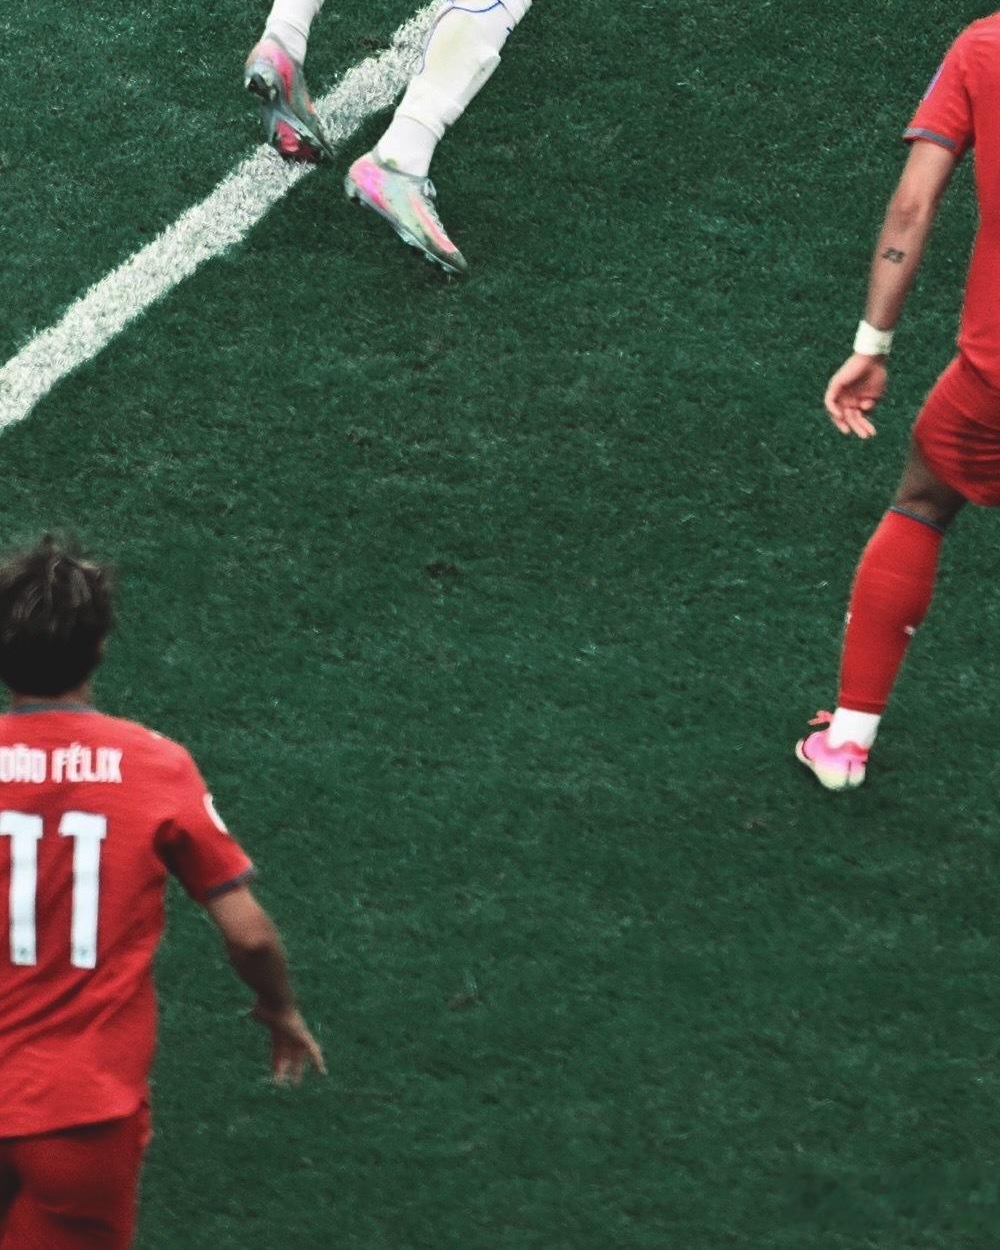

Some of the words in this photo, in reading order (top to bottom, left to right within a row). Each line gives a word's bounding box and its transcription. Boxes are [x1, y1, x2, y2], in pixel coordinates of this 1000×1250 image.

[0, 742, 48, 784] OÃO
[51, 740, 123, 784] FÉLIX
[0, 808, 108, 970] 11
